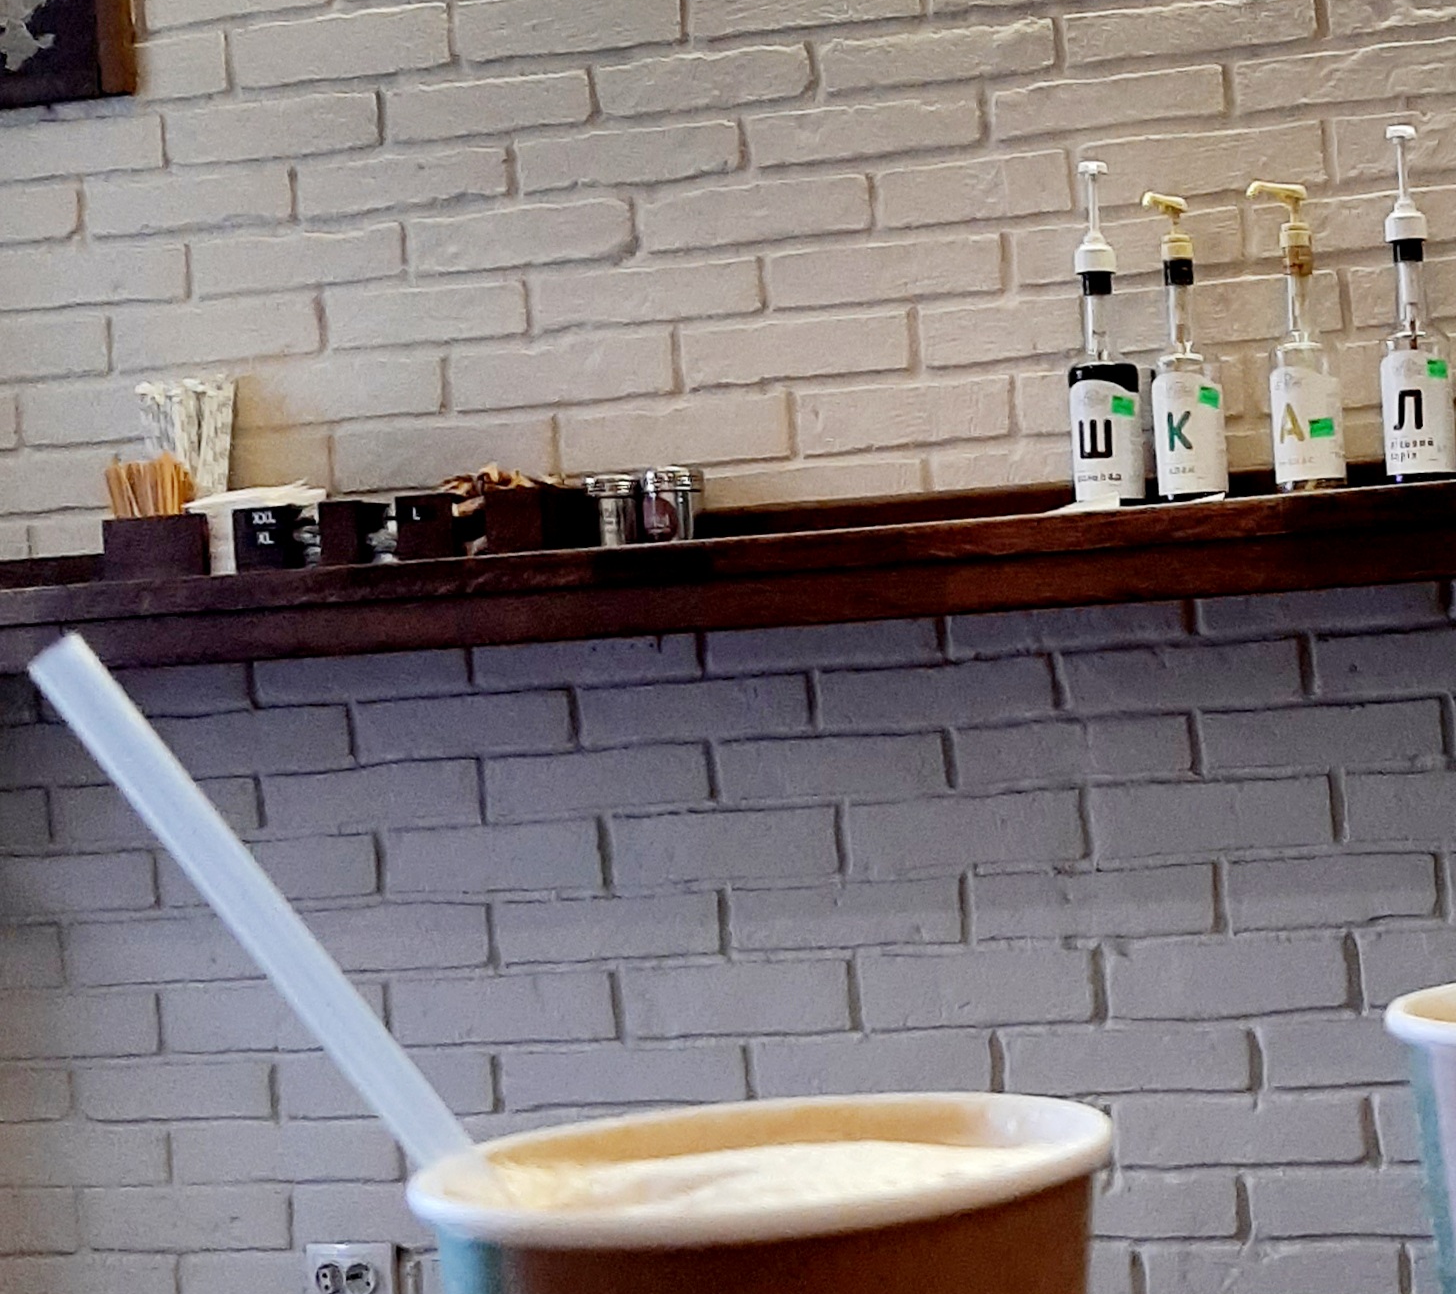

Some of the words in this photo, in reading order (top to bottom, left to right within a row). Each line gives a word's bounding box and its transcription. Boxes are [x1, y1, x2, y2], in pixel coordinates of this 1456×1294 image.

[1279, 403, 1305, 444] А
[1393, 389, 1424, 431] Л
[1079, 418, 1113, 459] Ш
[1166, 410, 1193, 452] К
[252, 510, 276, 524] XXL
[412, 507, 421, 521] L
[257, 531, 274, 545] XL
